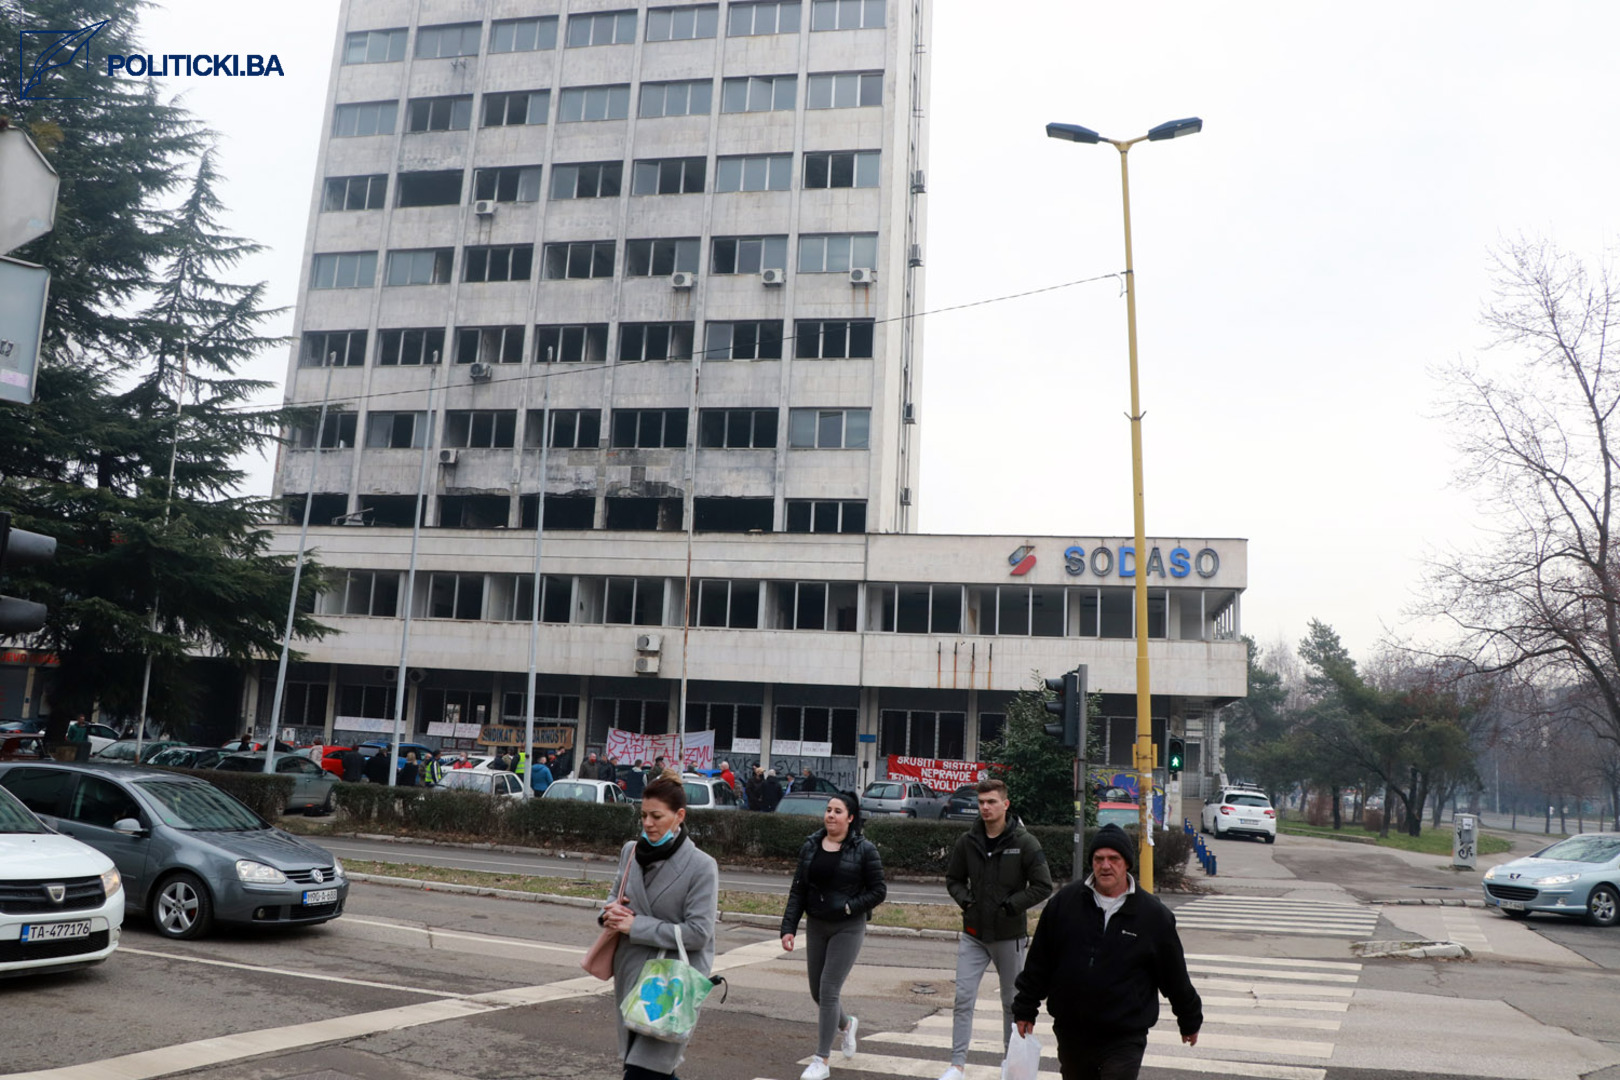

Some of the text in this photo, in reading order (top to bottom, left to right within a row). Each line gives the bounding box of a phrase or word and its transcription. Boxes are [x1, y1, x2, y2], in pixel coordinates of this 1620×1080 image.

[1064, 546, 1220, 579] SODASO
[609, 729, 680, 748] SMRT
[942, 761, 978, 771] SISTEM
[921, 768, 972, 782] NEPRAVDE
[30, 922, 90, 939] TA-477176
